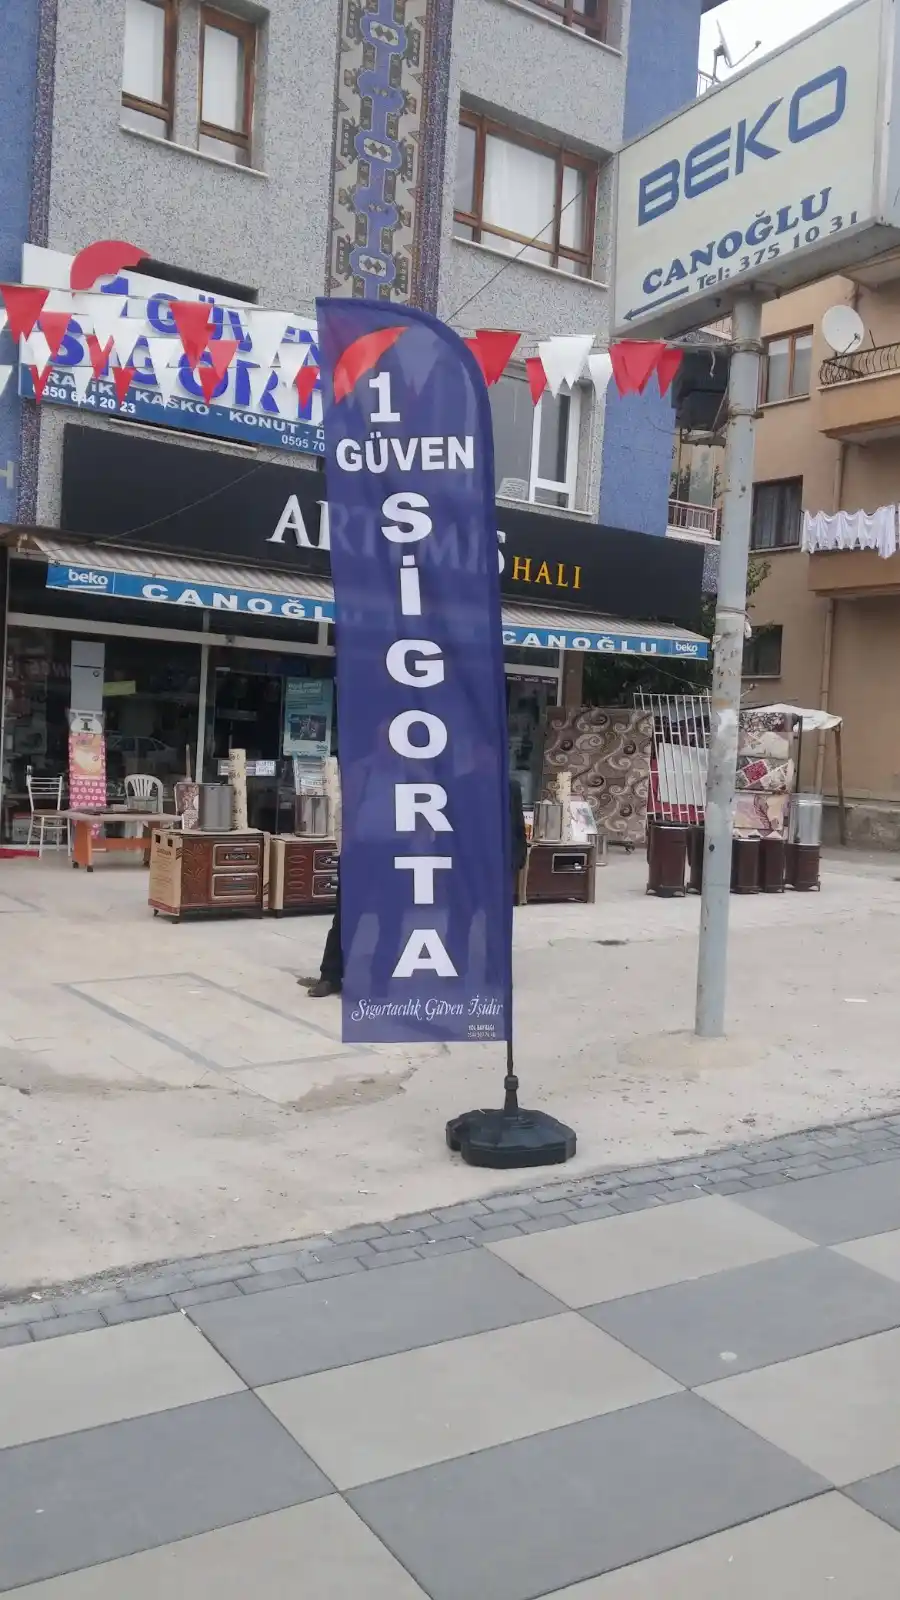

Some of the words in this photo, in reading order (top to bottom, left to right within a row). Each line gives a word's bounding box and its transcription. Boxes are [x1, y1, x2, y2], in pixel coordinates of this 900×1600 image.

[638, 66, 847, 227] BEKO
[642, 187, 832, 294] CANOĞLU
[697, 268, 731, 290] Tel:
[738, 242, 781, 272] 375
[793, 226, 820, 249] 10
[99, 397, 117, 410] 20
[119, 401, 136, 414] 23
[369, 372, 401, 423] 1
[229, 410, 299, 434] KONUT
[336, 431, 475, 474] GÜVEN
[512, 555, 582, 589] HALI
[67, 569, 109, 585] beko
[141, 583, 335, 622] CANOĞL
[502, 630, 657, 654] CANOĞLU
[675, 642, 698, 652] beko
[351, 999, 422, 1022] Sigortacılık
[425, 997, 464, 1021] Güven
